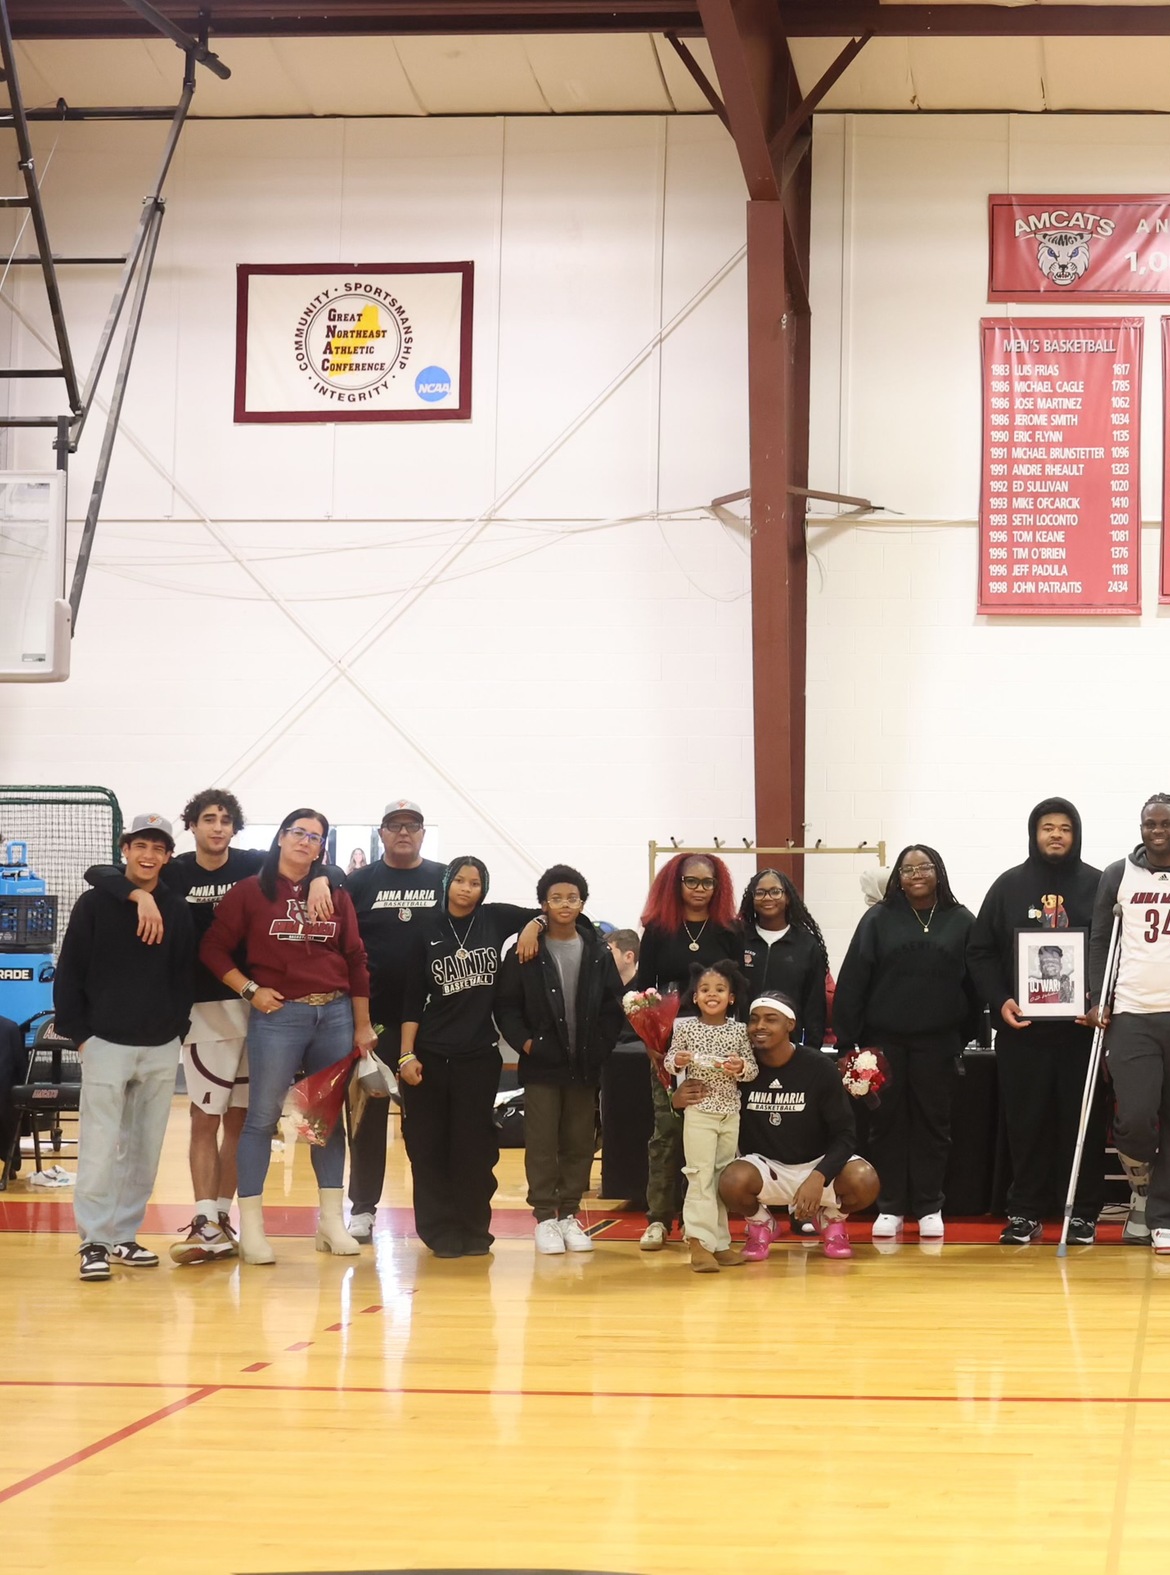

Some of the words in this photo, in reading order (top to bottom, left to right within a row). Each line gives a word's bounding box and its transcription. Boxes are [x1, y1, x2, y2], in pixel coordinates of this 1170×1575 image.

[1014, 210, 1116, 237] AMCATS
[294, 289, 331, 372] COMMUNITY
[343, 282, 414, 370] SPORTSMANSHIP
[1003, 339, 1040, 353] MEN'S
[1043, 339, 1117, 353] BASKETBALL
[991, 364, 1010, 376] 1983
[1014, 364, 1032, 376] LUIS
[1035, 364, 1059, 376] FRIAS
[1112, 363, 1130, 375] 1617
[313, 380, 389, 403] INTEGRITY
[417, 382, 450, 394] NCAA
[991, 381, 1010, 393] 1986
[1014, 381, 1053, 393] MICHAEL
[1056, 381, 1084, 393] CAGLE
[1112, 380, 1130, 392] 1785
[991, 397, 1010, 409] 1986
[1014, 397, 1034, 409] JOSE
[1037, 397, 1082, 409] MARTINEZ
[1111, 397, 1130, 409] 1062
[991, 414, 1010, 426] 1986
[1014, 414, 1048, 426] JEROME
[1050, 414, 1078, 426] SMITH
[1110, 413, 1130, 425] 1034
[990, 431, 1009, 443] 1990
[1014, 431, 1032, 443] ERIC
[1035, 431, 1063, 443] FLYNN
[1112, 430, 1130, 442] 1135
[990, 447, 1008, 459] 1991
[1011, 447, 1048, 459] MICHAEL
[1050, 447, 1105, 459] BRUNSTETTER
[1111, 447, 1129, 458] 1096
[989, 464, 1008, 476] 1991
[1012, 464, 1042, 476] ANDRE
[1045, 464, 1085, 476] RHEAULT
[1111, 463, 1129, 475] 1323
[989, 480, 1008, 493] 1992
[1012, 480, 1024, 493] ED
[1027, 480, 1069, 493] SULLIVAN
[1110, 480, 1129, 492] 1020
[989, 497, 1008, 509] 1993
[1012, 497, 1034, 509] MIKE
[1111, 496, 1129, 508] 1410
[989, 514, 1008, 526] 1993
[1012, 514, 1033, 526] SETH
[1036, 514, 1079, 526] LOCONTO
[1110, 513, 1129, 525] 1200
[989, 530, 1008, 543] 1996
[1012, 530, 1033, 543] TOM
[1036, 530, 1066, 543] KEANE
[1111, 530, 1129, 542] 1081
[989, 547, 1008, 560] 1996
[1012, 547, 1029, 560] TIM
[1031, 547, 1066, 560] O'BRIEN
[1110, 547, 1129, 559] 1376
[988, 564, 1008, 576] 1996
[1012, 564, 1030, 576] JEFF
[1032, 564, 1068, 576] PADULA
[1111, 564, 1129, 576] 1118
[988, 581, 1008, 594] 1998
[1012, 581, 1035, 594] JOHN
[1038, 581, 1082, 594] PATRAITIS
[1107, 580, 1128, 593] 2434
[189, 885, 215, 897] ANNA
[375, 890, 402, 901] ANNA
[403, 889, 435, 901] MARIA
[1130, 892, 1160, 904] ANNA
[431, 946, 498, 985] SAINTS
[748, 1091, 773, 1104] ANNA
[774, 1092, 805, 1104] MARIA
